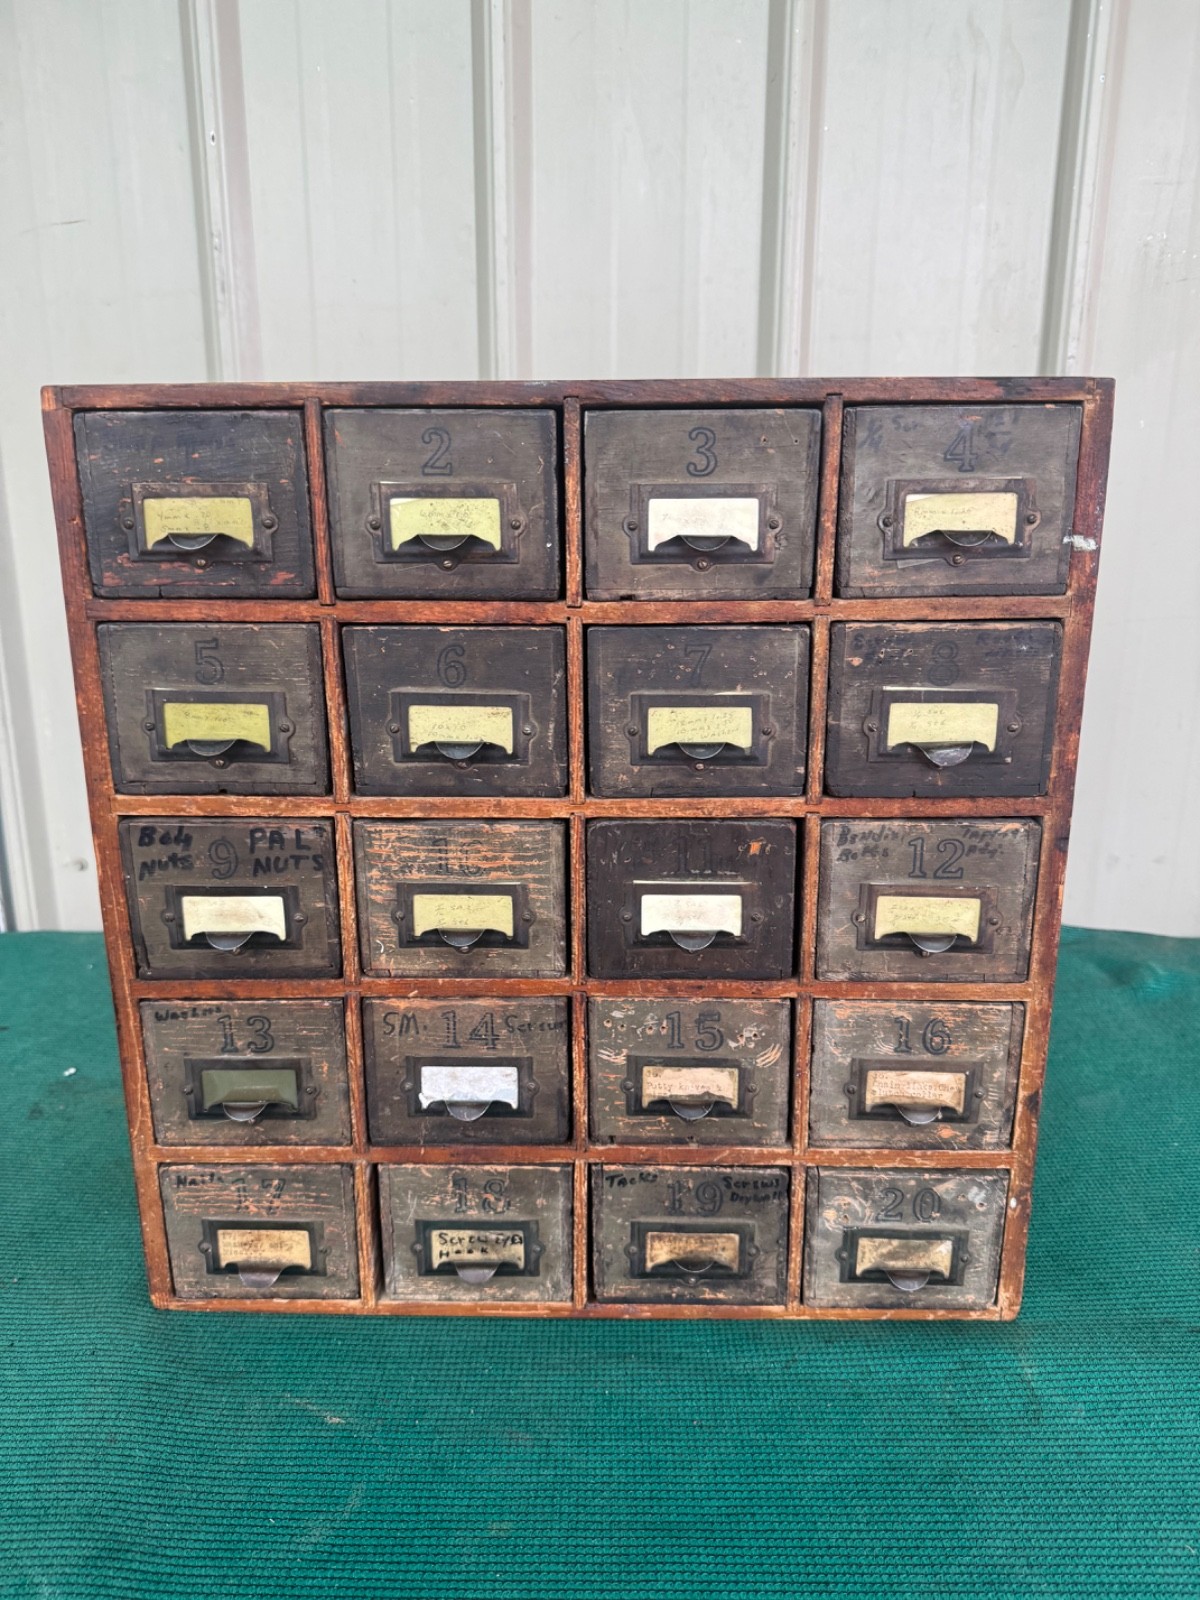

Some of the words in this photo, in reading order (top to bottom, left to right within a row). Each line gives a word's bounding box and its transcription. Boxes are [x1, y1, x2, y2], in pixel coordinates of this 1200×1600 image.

[421, 427, 453, 476] 2
[686, 426, 718, 477] 3
[943, 422, 979, 473] 4
[194, 637, 225, 685] 5
[437, 644, 467, 688] 6
[684, 642, 713, 689] 7
[928, 640, 960, 686] 8
[208, 836, 239, 880] 9
[253, 853, 326, 877] NUTS
[907, 836, 966, 879] 12
[217, 1014, 275, 1054] 13
[440, 1009, 501, 1050] 14
[665, 1010, 725, 1052] 15
[893, 1015, 953, 1055] 16
[231, 1177, 287, 1216] 17
[452, 1176, 511, 1214] 18
[667, 1179, 724, 1217] 19
[876, 1187, 942, 1222] 20
